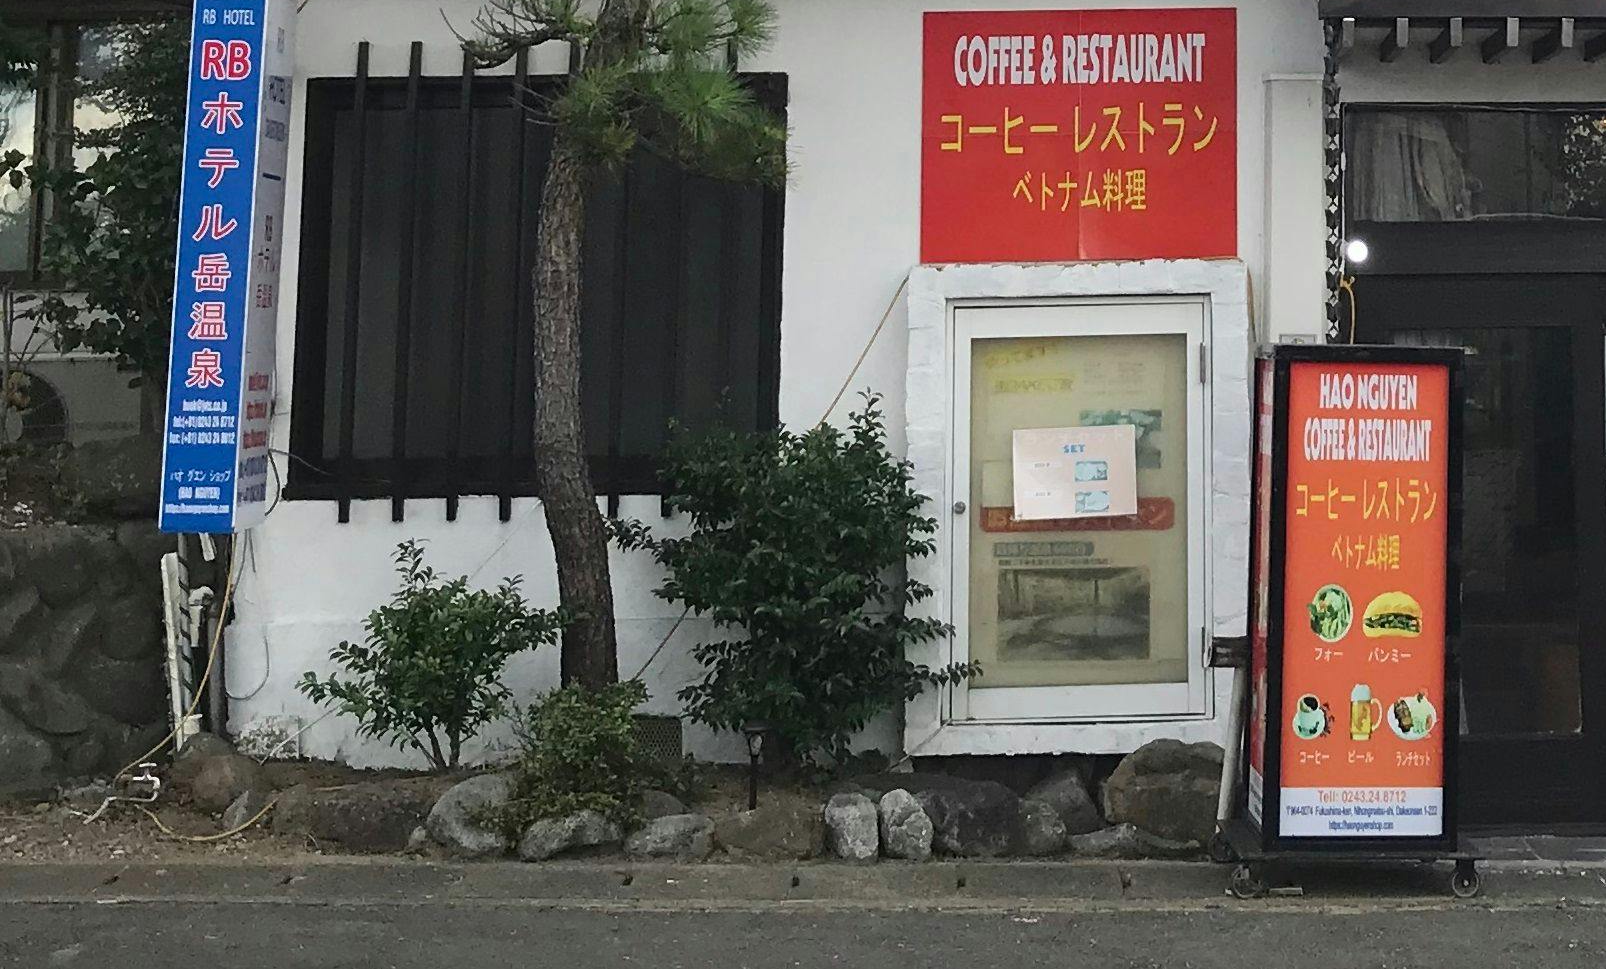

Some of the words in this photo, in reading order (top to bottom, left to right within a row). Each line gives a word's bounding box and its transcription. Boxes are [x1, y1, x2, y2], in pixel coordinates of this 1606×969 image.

[202, 8, 217, 25] RB
[223, 9, 256, 26] HOTEL
[954, 34, 1036, 86] COFFEE
[1040, 34, 1057, 85] &
[1062, 33, 1206, 85] RESTAURANT
[1012, 168, 1147, 212] ベトナム料理
[1319, 373, 1355, 409] HAO
[1357, 374, 1417, 410] NGUYEN
[1063, 443, 1086, 454] SET
[1304, 417, 1346, 461] COFFEE
[1347, 418, 1356, 460] &
[1358, 418, 1431, 462] RESTAURANT
[1332, 535, 1400, 571] ベトナム料理
[1314, 647, 1344, 662] フォー
[1300, 750, 1330, 765] コーヒー
[1342, 790, 1407, 803] 0243.24.8712
